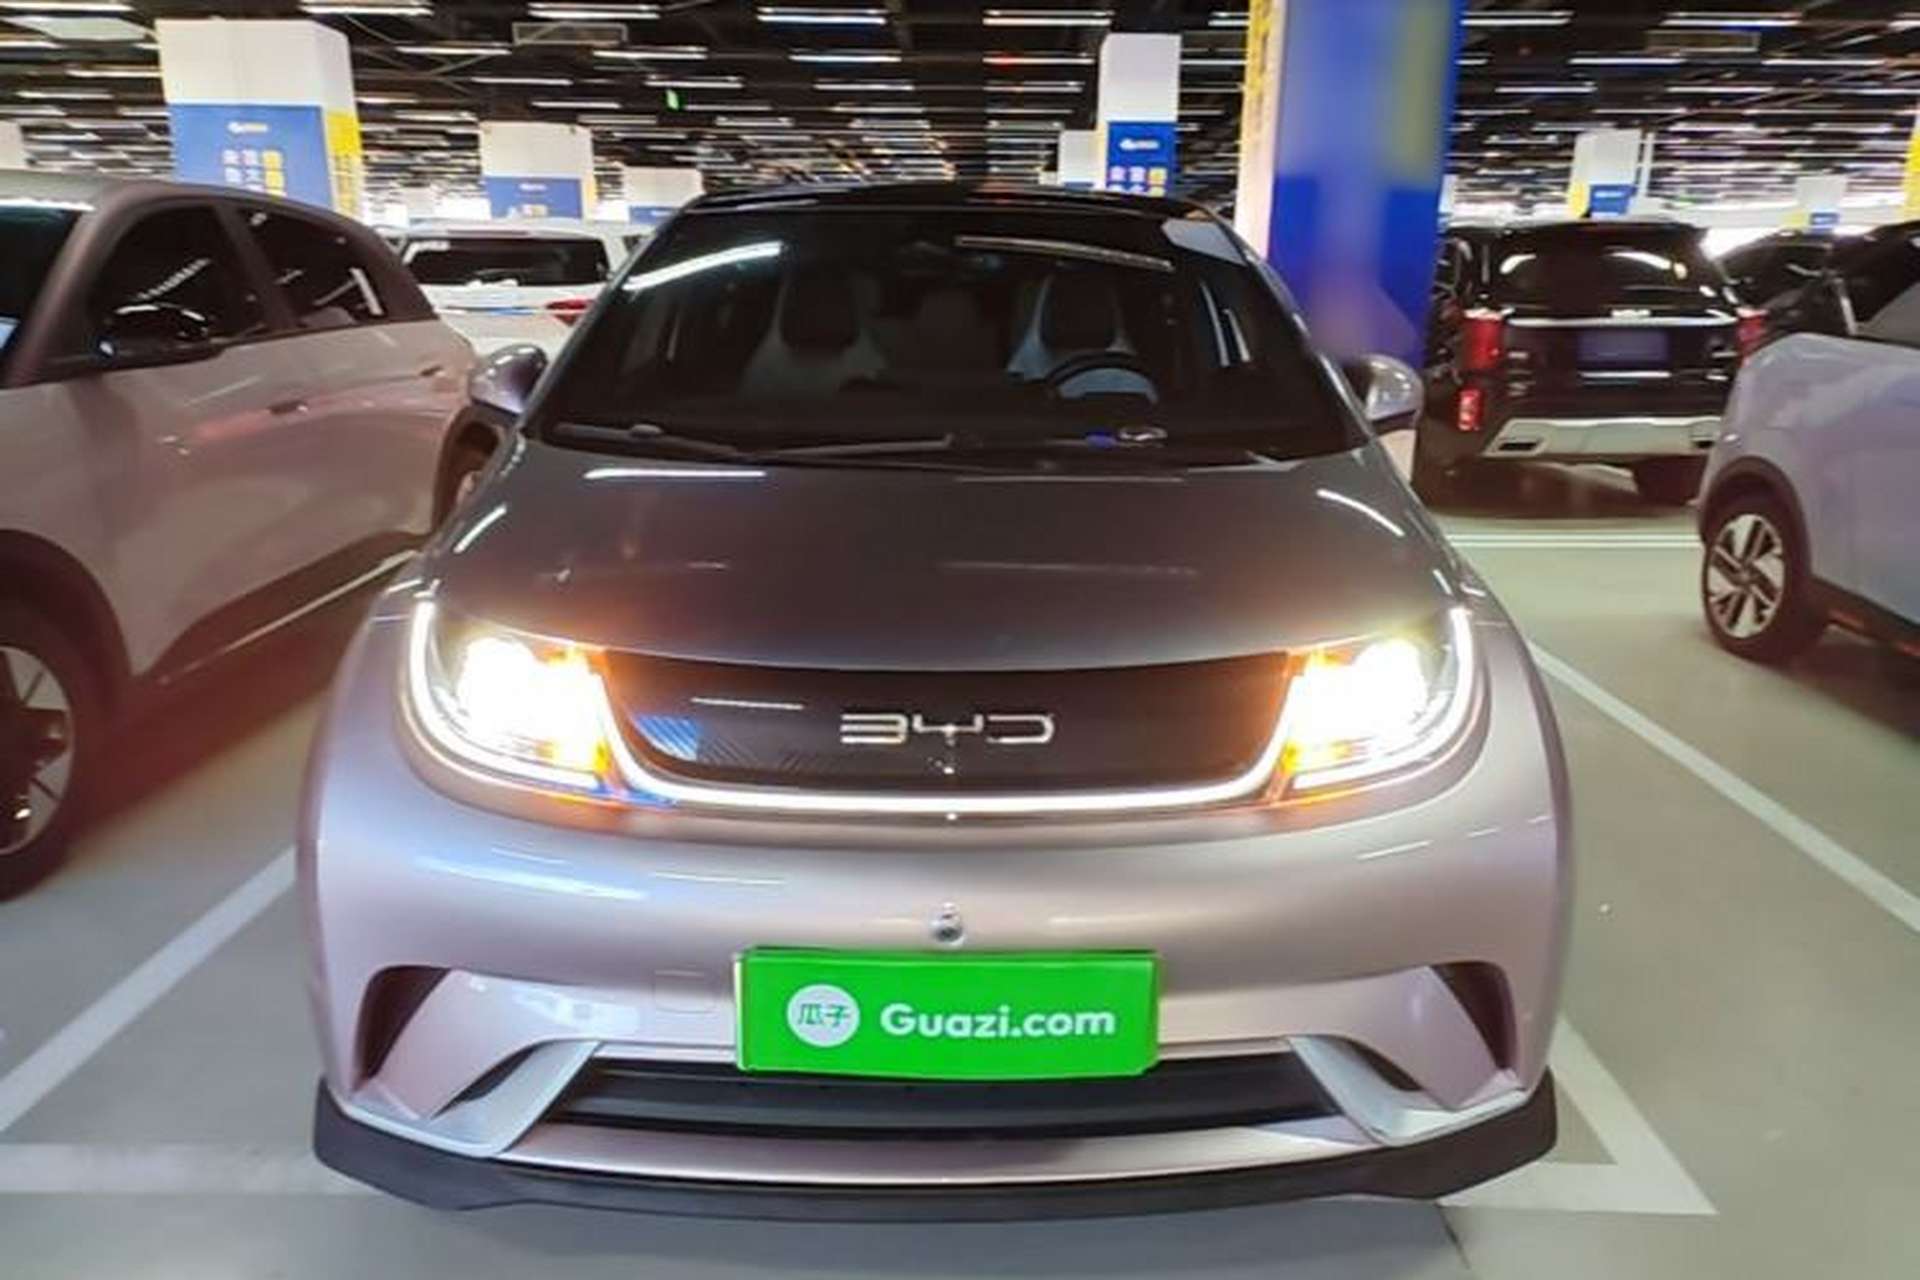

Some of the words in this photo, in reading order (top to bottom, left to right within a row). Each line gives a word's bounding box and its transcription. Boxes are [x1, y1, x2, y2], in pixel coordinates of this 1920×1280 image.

[839, 713, 1055, 745] BYD
[797, 1003, 851, 1028] 瓜子
[880, 1004, 1116, 1038] Guazi.com
